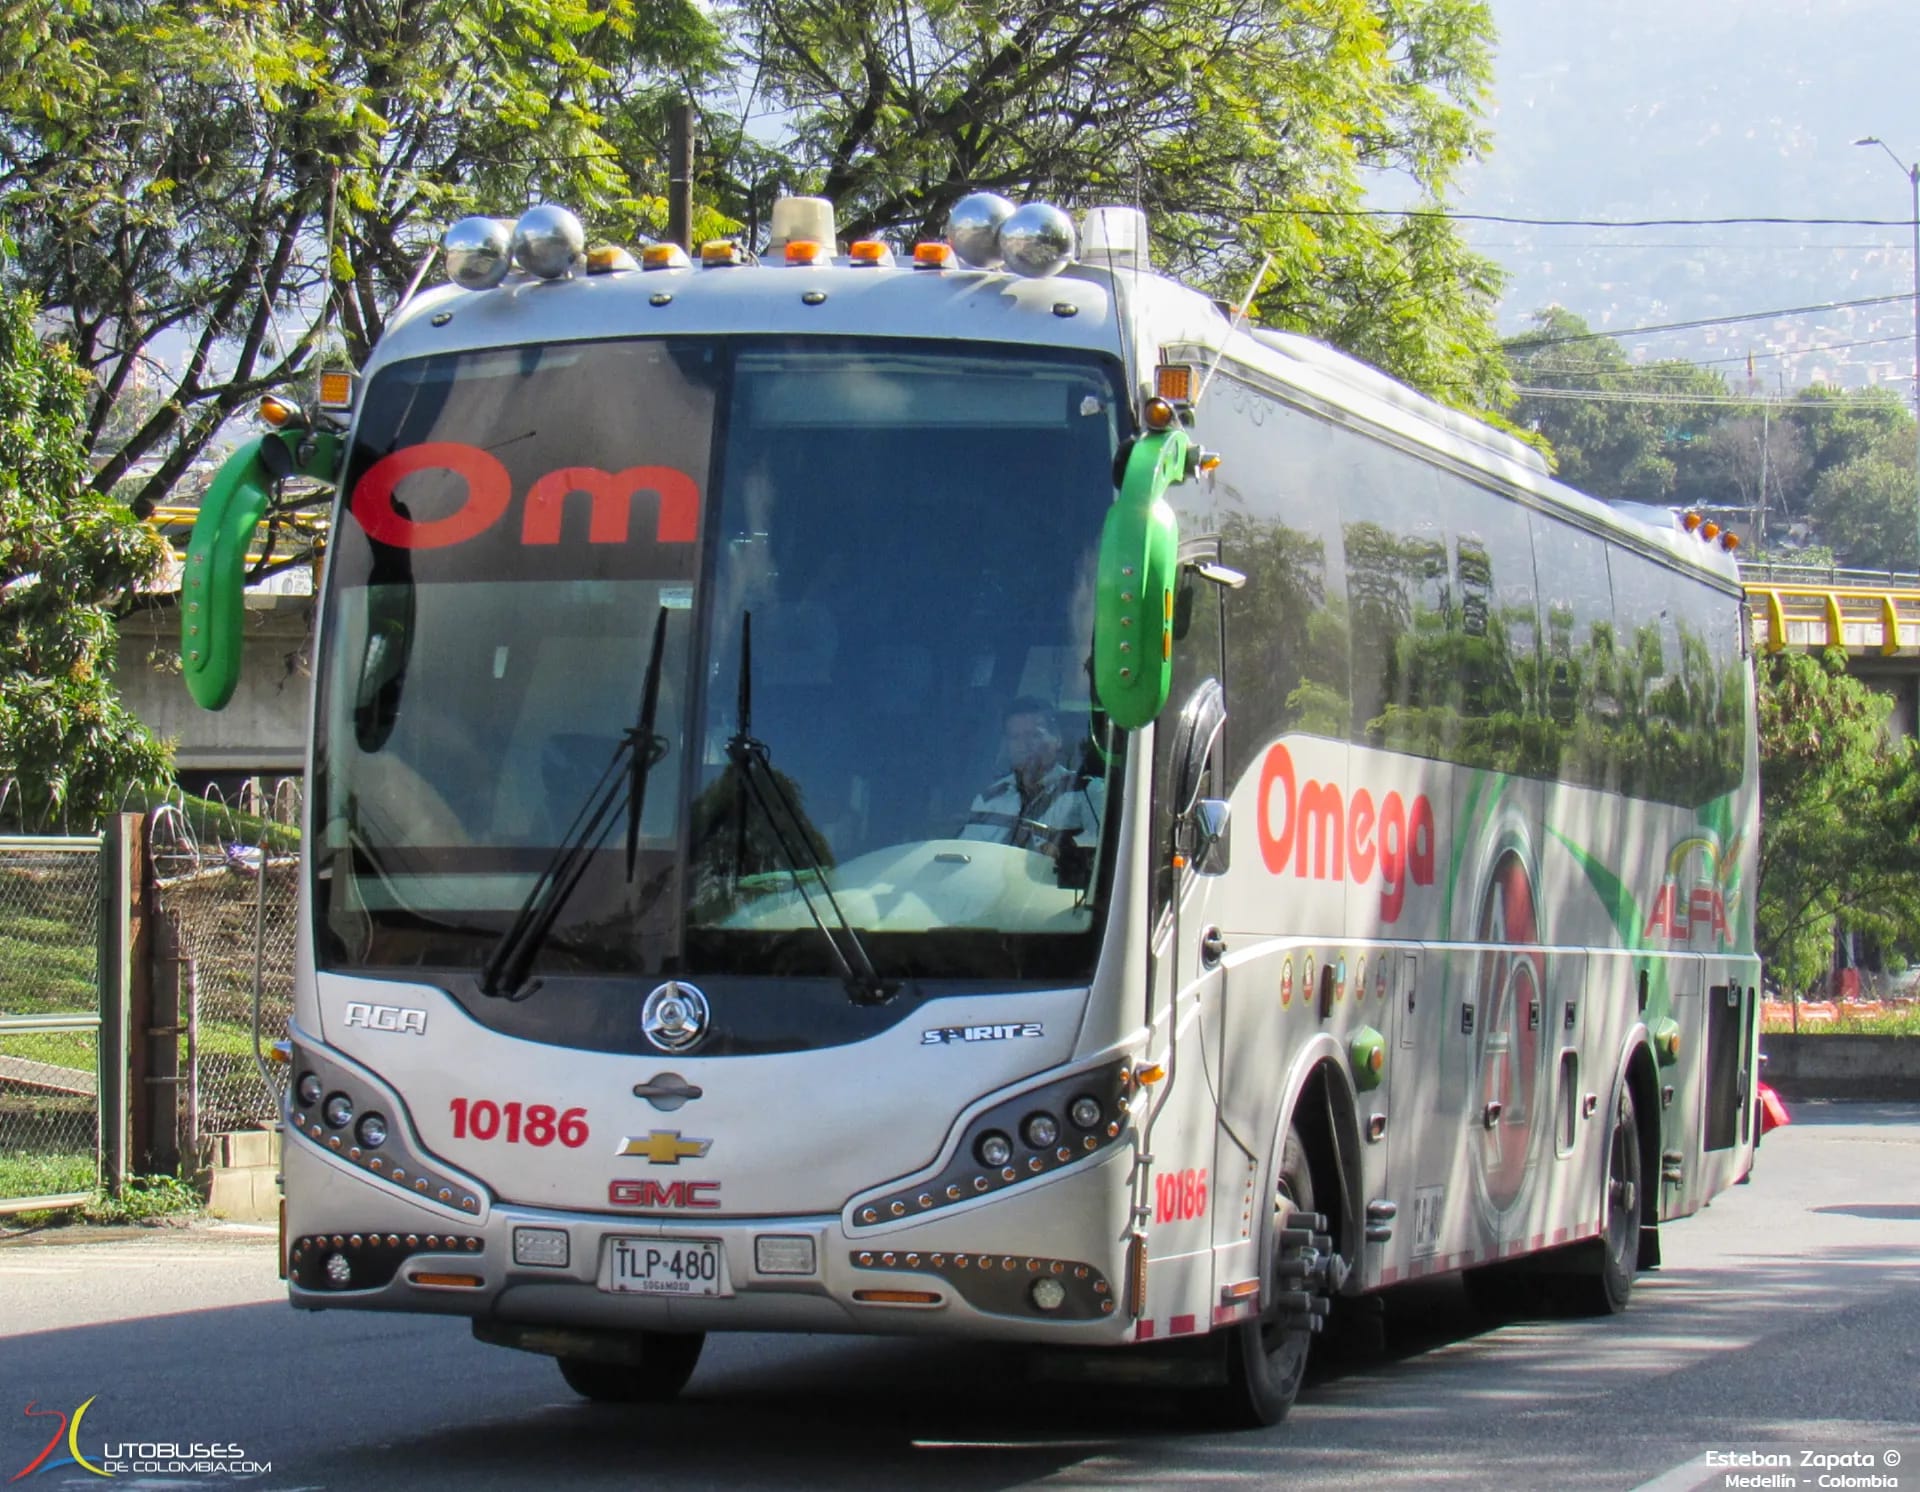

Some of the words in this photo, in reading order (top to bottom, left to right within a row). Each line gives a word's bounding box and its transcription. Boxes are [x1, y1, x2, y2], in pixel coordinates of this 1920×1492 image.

[352, 441, 699, 549] Om
[1257, 743, 1434, 923] Omega
[1643, 883, 1734, 944] ALFA
[344, 1001, 428, 1035] AGA
[450, 1097, 589, 1148] 10186
[608, 1179, 721, 1208] GMC
[1155, 1167, 1208, 1224] 10186
